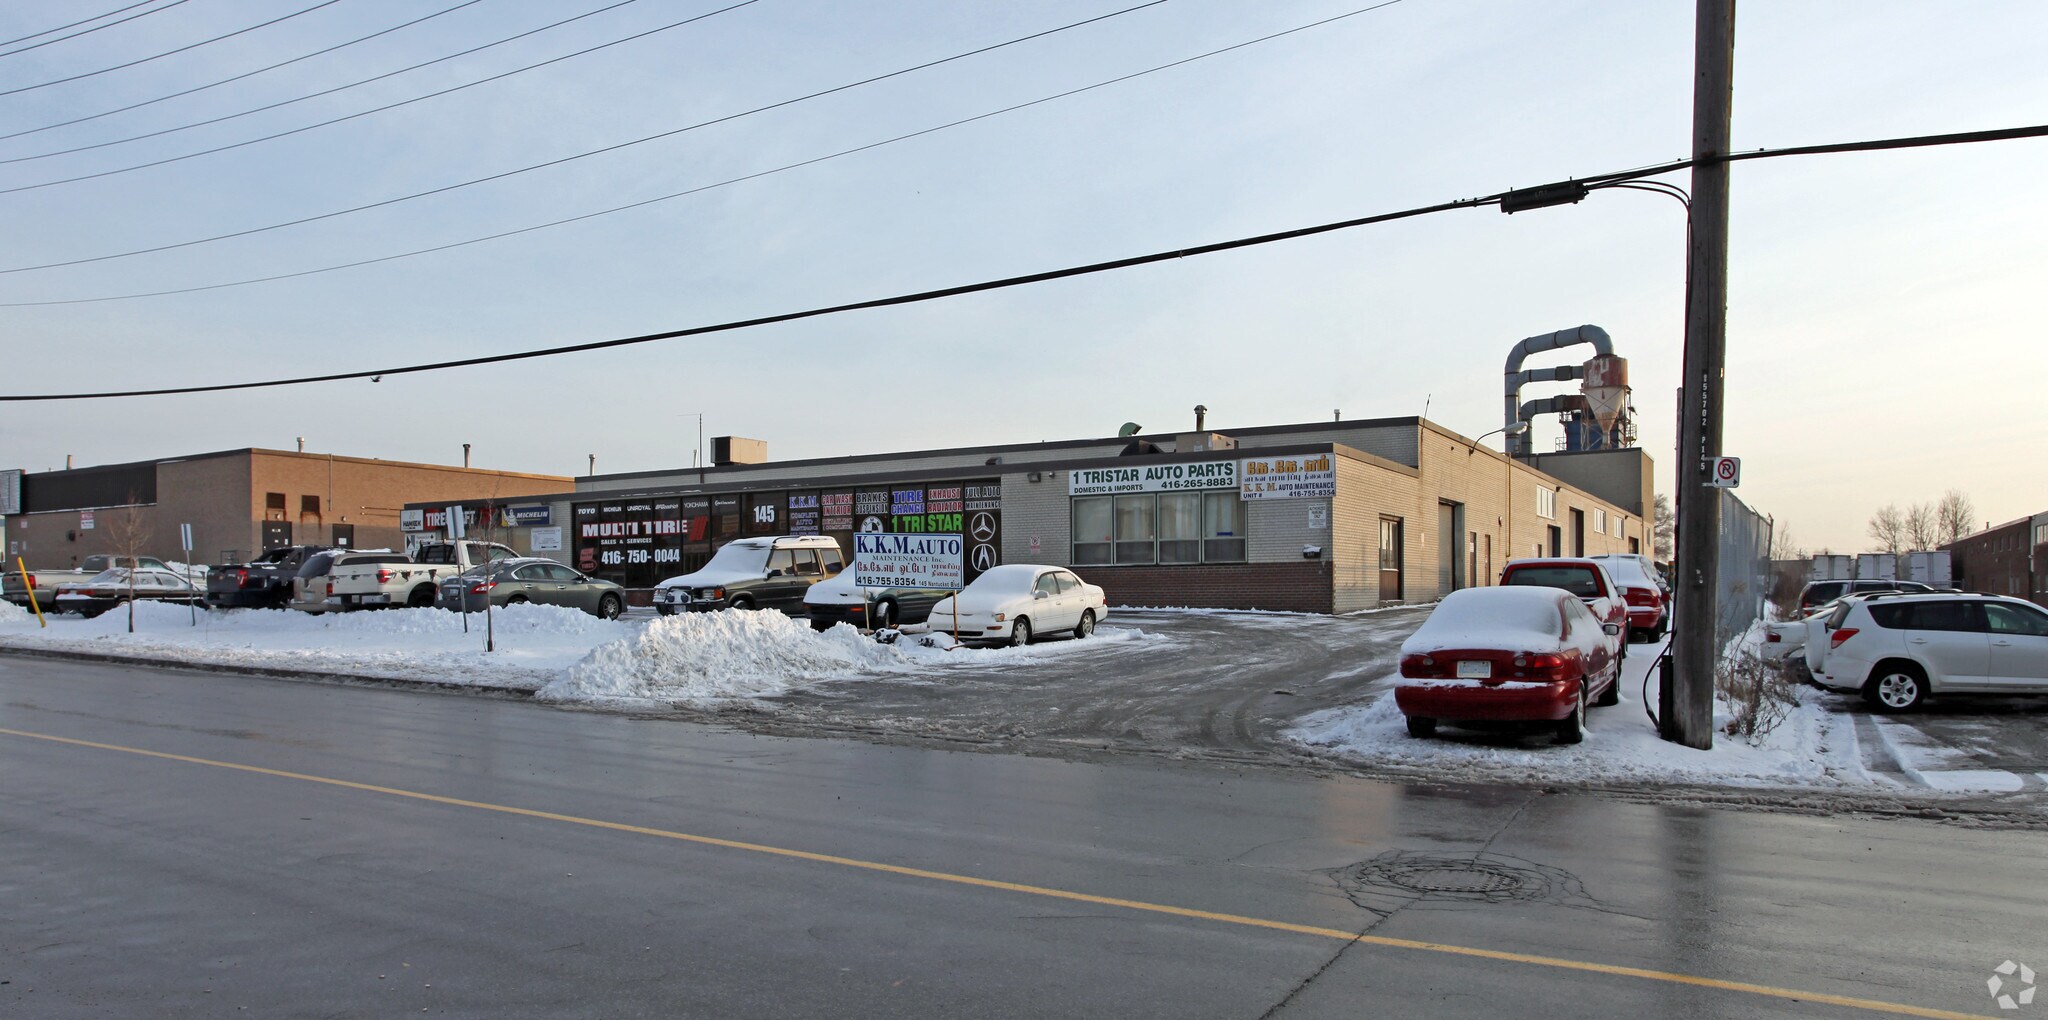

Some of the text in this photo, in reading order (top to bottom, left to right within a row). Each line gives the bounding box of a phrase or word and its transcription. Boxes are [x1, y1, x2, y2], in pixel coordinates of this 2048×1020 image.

[1073, 462, 1233, 484] 1 TRISTAR AUTO PARTS
[965, 486, 1000, 498] FULL AUTO
[1074, 486, 1106, 494] DOMESTIC
[1294, 482, 1334, 490] MAINTENANCE
[821, 494, 854, 505] CAR WASH
[856, 493, 888, 503] BRAKES
[892, 490, 923, 503] TIRE
[928, 488, 961, 500] EXHAUST
[823, 505, 852, 516] INTERIOR
[856, 503, 889, 514] SUSPENSION
[891, 503, 925, 515] CHANGE
[927, 501, 963, 513] RADIATOR
[753, 505, 775, 523] 145
[582, 520, 688, 537] MULTI TIRE
[892, 516, 898, 532] 1
